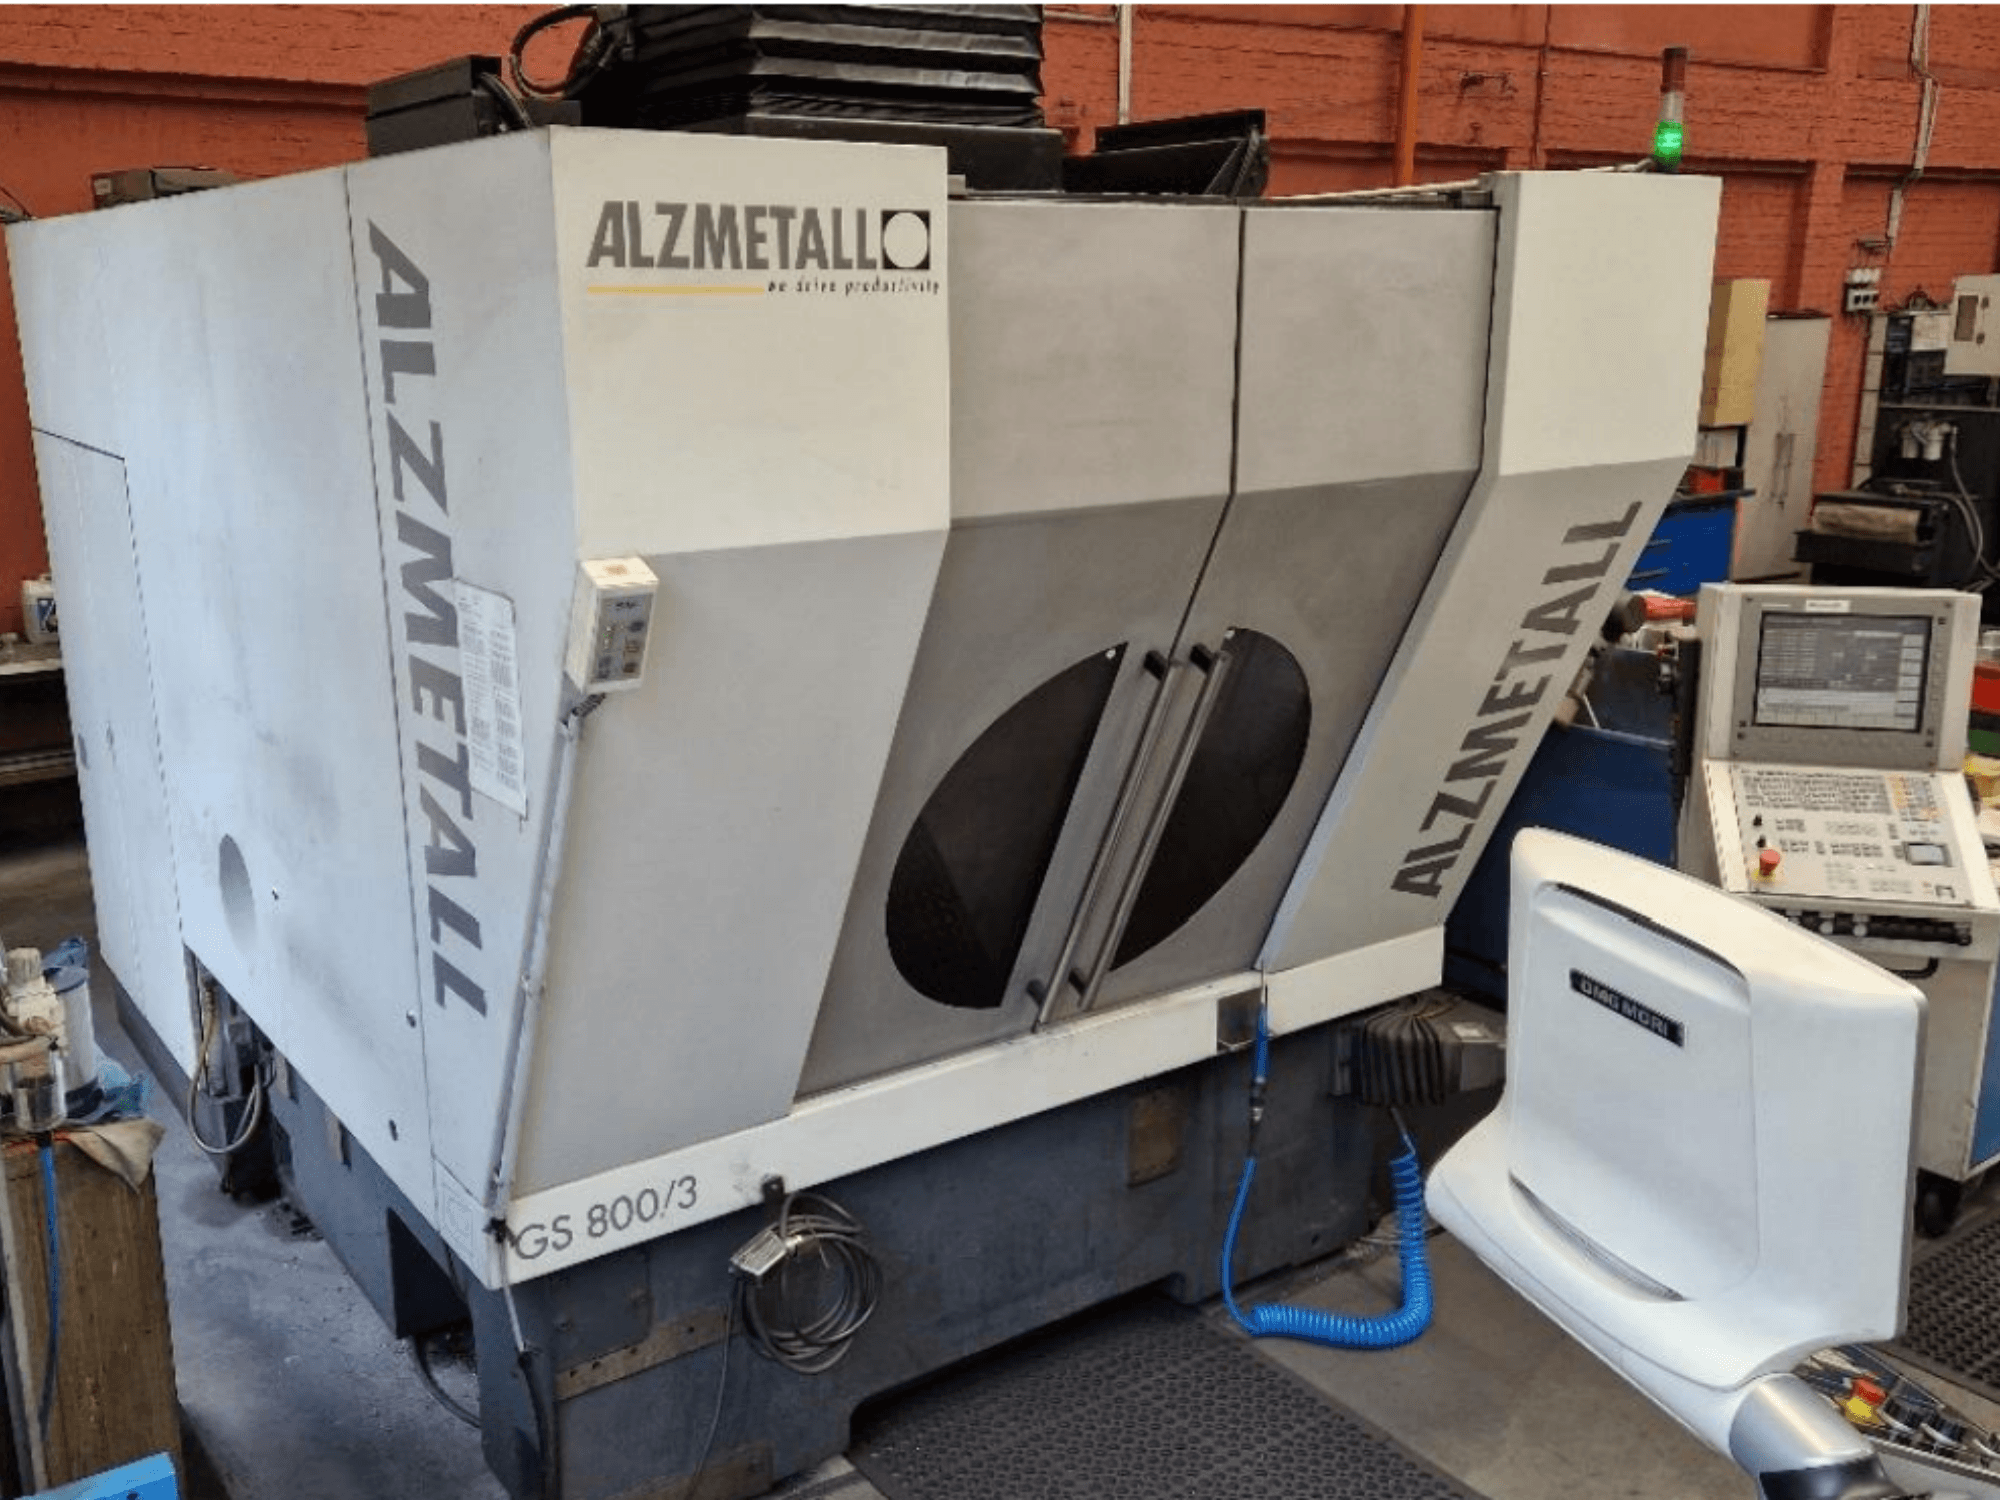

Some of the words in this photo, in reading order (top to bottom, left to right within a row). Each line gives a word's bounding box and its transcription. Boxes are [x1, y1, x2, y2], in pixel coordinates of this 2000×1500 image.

[585, 200, 877, 270] ALZMETALL
[368, 219, 487, 1017] ALZMETALL
[1390, 501, 1642, 898] ALZMETALL
[1580, 980, 1619, 1011] DMG
[1621, 1000, 1669, 1037] MORI
[515, 1214, 573, 1260] GS
[587, 1175, 697, 1238] 800/3
